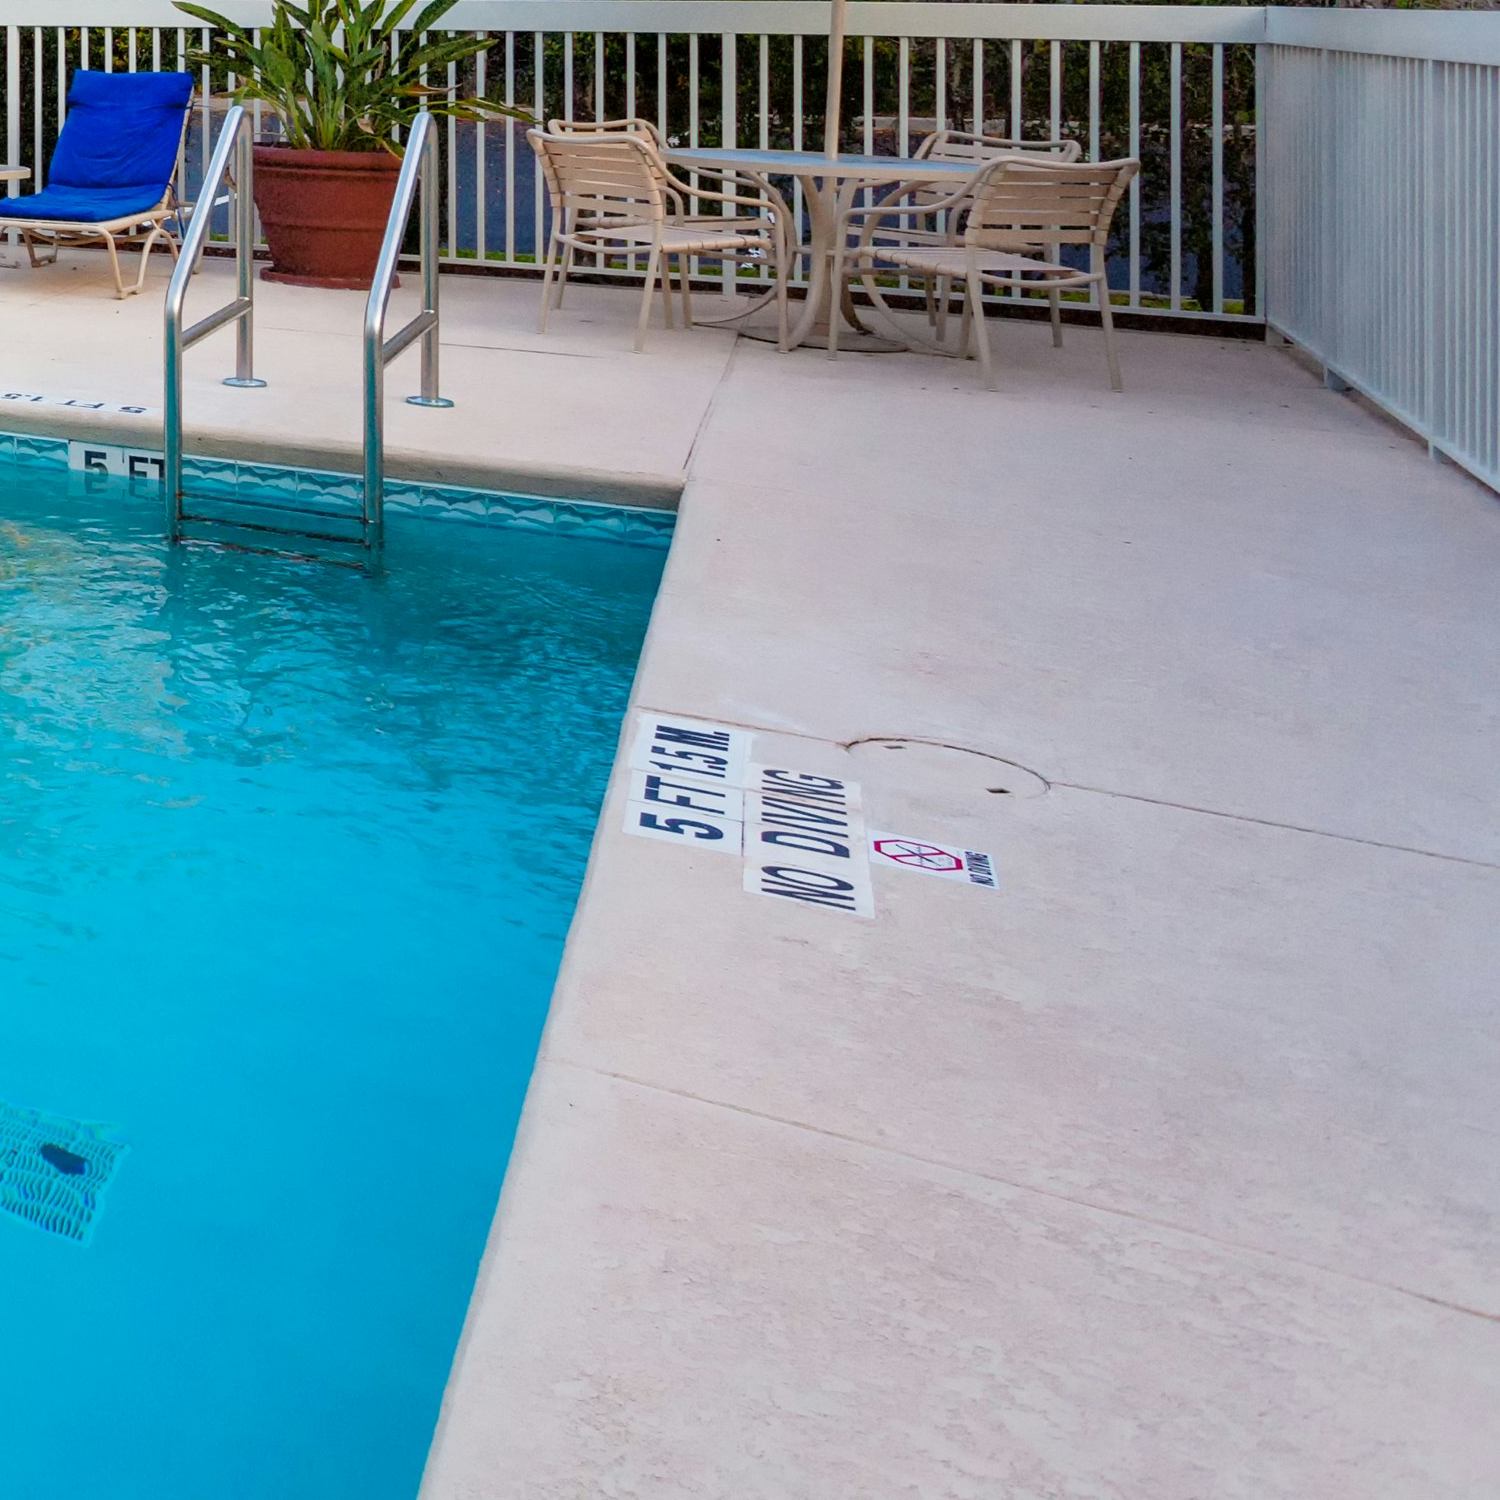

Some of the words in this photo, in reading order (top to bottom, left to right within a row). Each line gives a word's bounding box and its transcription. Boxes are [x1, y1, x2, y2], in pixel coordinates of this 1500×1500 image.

[1, 393, 44, 402] 1.5
[56, 399, 104, 409] FT
[118, 406, 147, 414] 5
[84, 450, 108, 476] 5
[649, 745, 729, 778] 1.5
[644, 774, 726, 815] FT
[639, 811, 724, 840] 5
[761, 769, 850, 858] DIVING
[761, 865, 856, 911] NO
